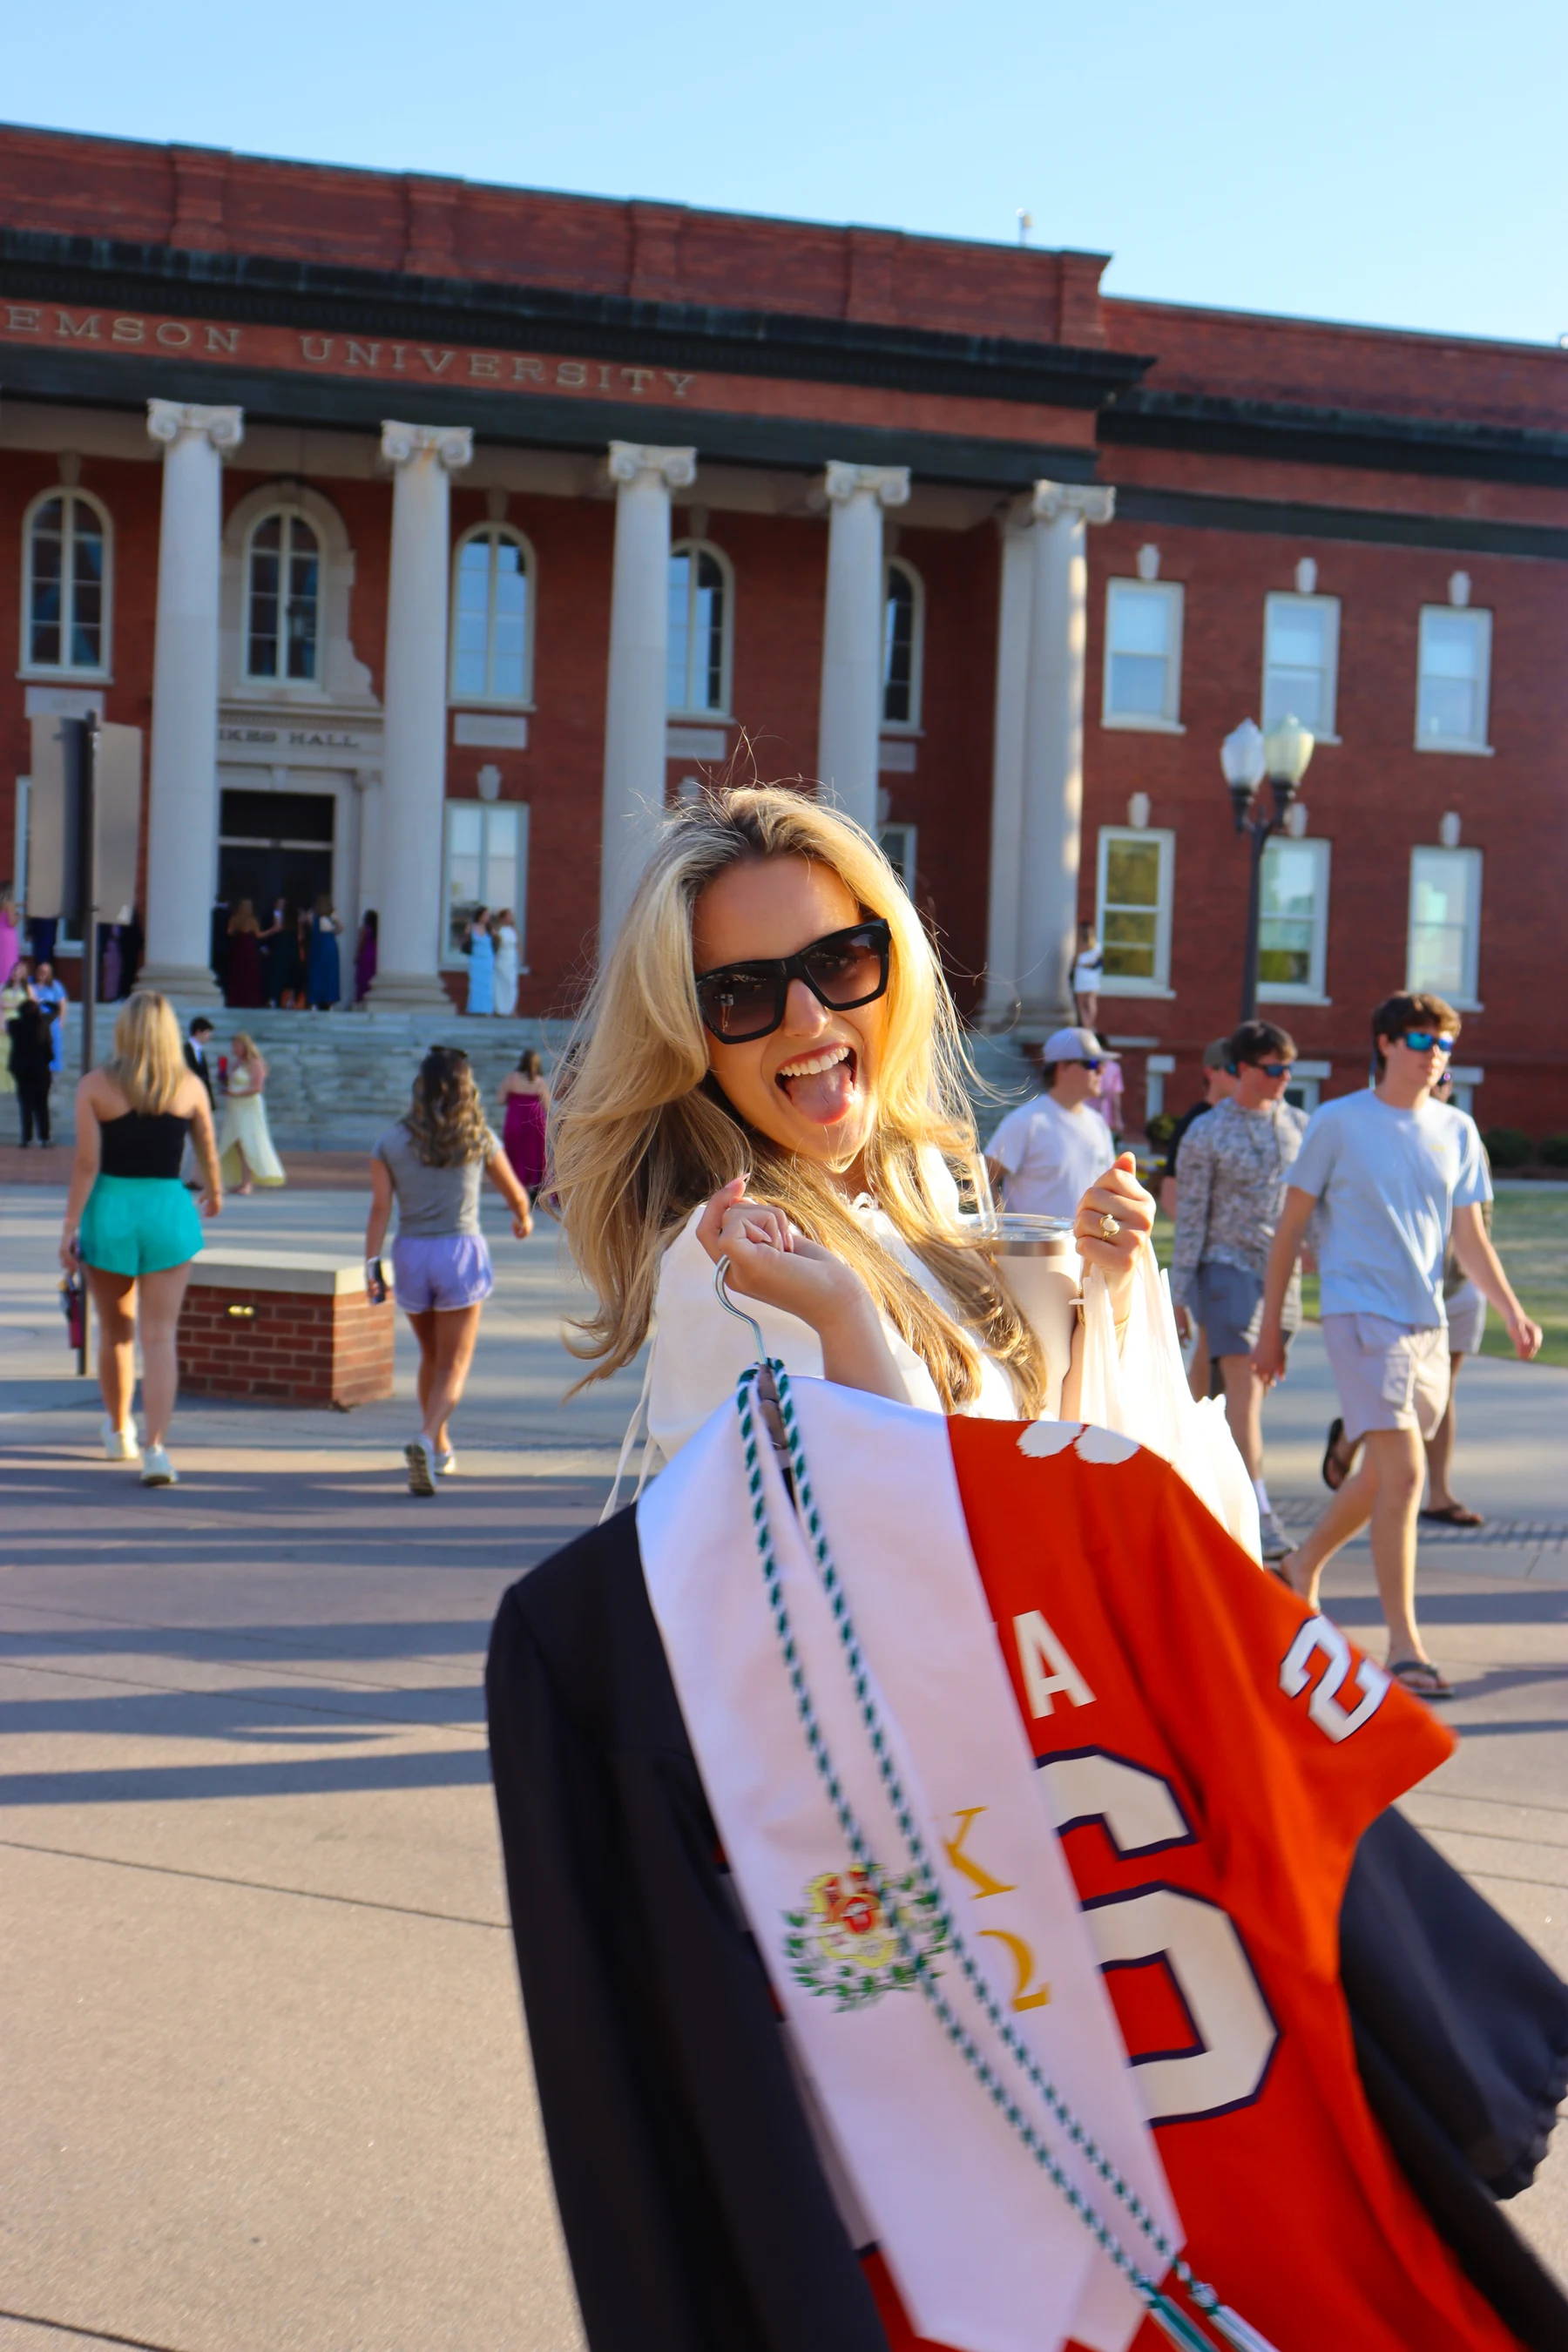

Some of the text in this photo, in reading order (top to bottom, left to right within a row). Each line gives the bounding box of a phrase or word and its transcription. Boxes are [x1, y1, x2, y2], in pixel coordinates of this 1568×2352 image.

[4, 305, 698, 397] EMSON UNIVERSITY
[288, 732, 360, 747] HALL
[1012, 1609, 1098, 1720] A
[1278, 1613, 1395, 1745] 2
